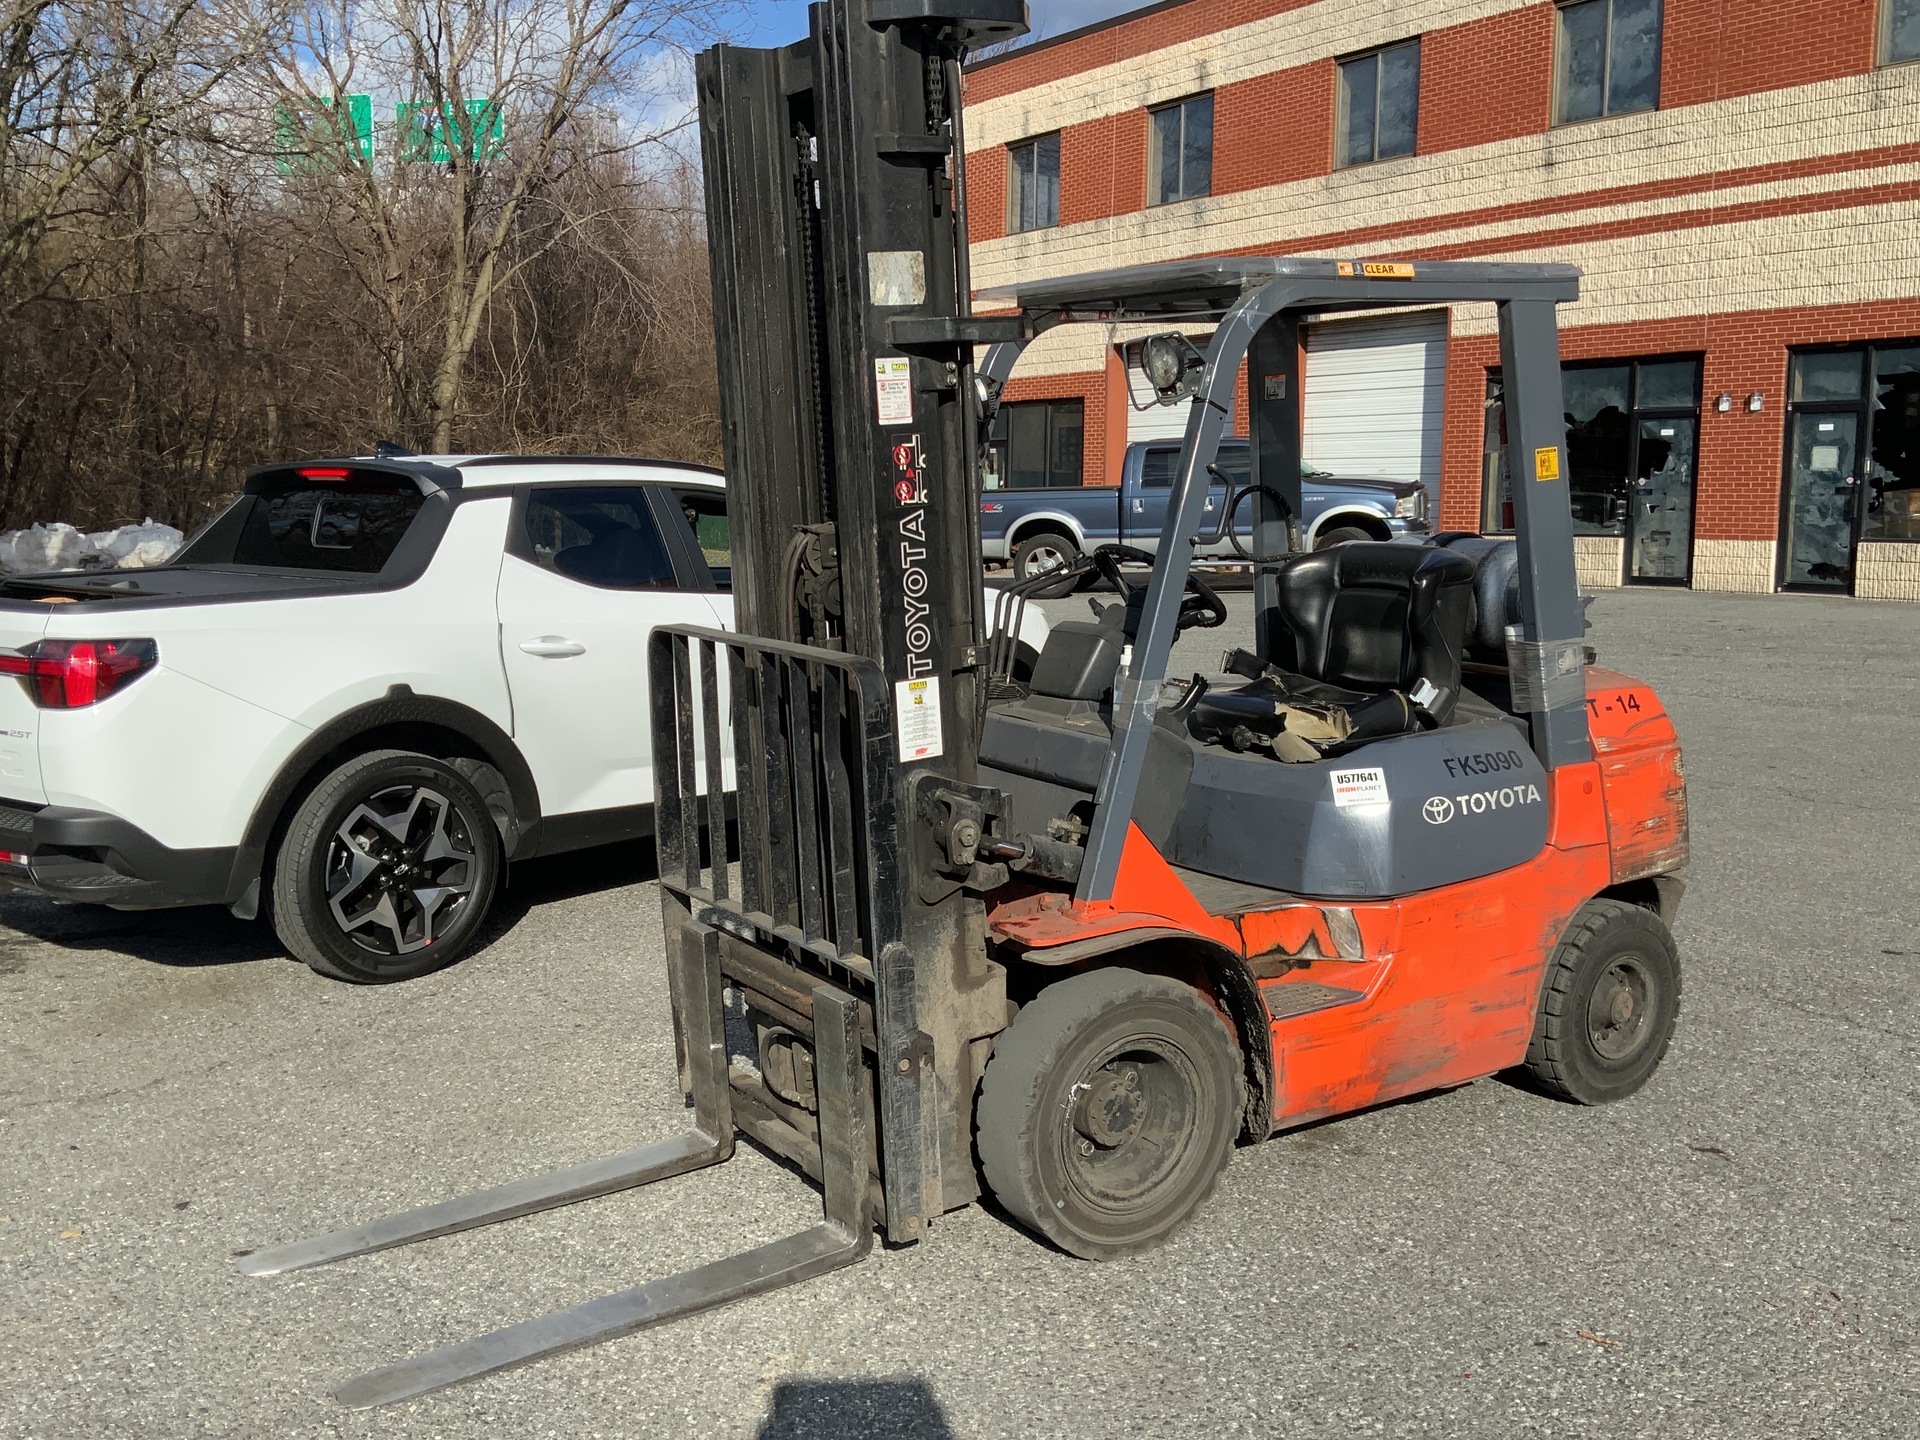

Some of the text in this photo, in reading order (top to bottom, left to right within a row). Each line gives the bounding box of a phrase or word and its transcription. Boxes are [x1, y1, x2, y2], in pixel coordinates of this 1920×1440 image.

[448, 103, 481, 116] EST
[899, 508, 932, 680] TOYOTA
[1336, 772, 1378, 784] U577641
[1442, 749, 1523, 779] FK5090
[1456, 784, 1541, 815] TOYOTA
